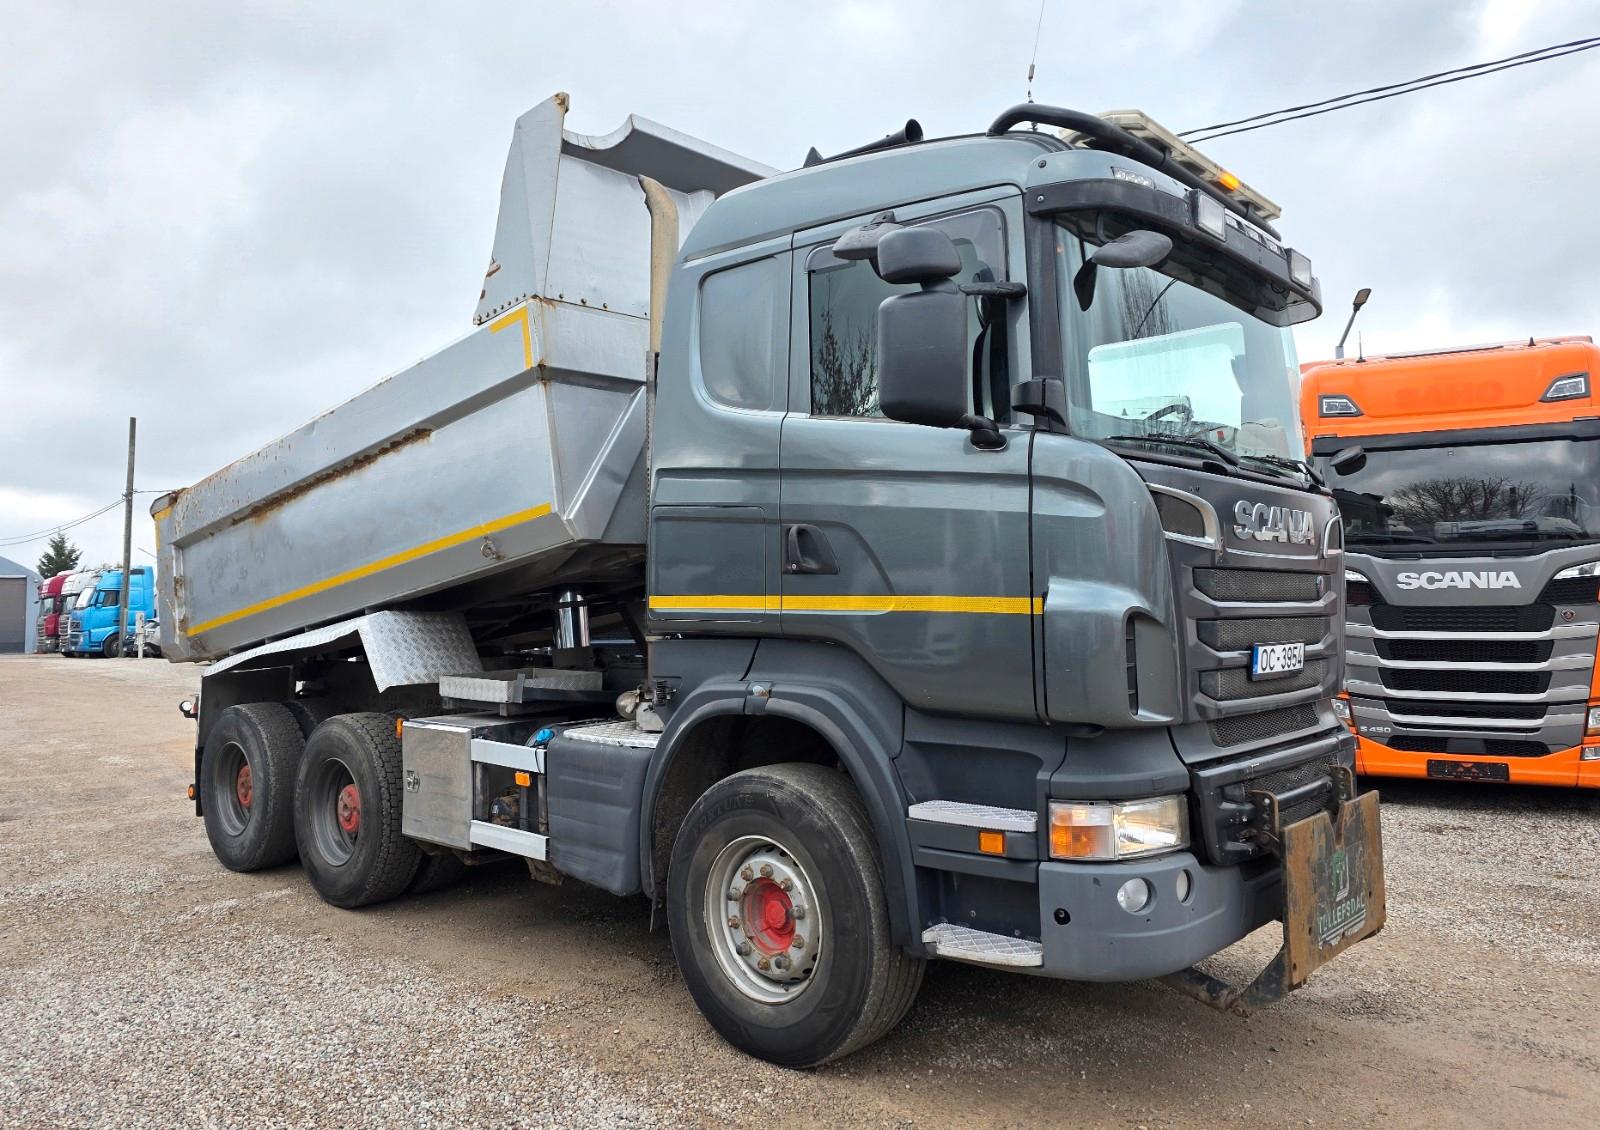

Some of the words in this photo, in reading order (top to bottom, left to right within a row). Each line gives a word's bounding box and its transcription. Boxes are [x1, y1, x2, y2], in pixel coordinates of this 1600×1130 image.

[1233, 500, 1315, 545] SCANIA
[1397, 571, 1521, 589] SCANIA
[1260, 645, 1303, 672] OC-3954
